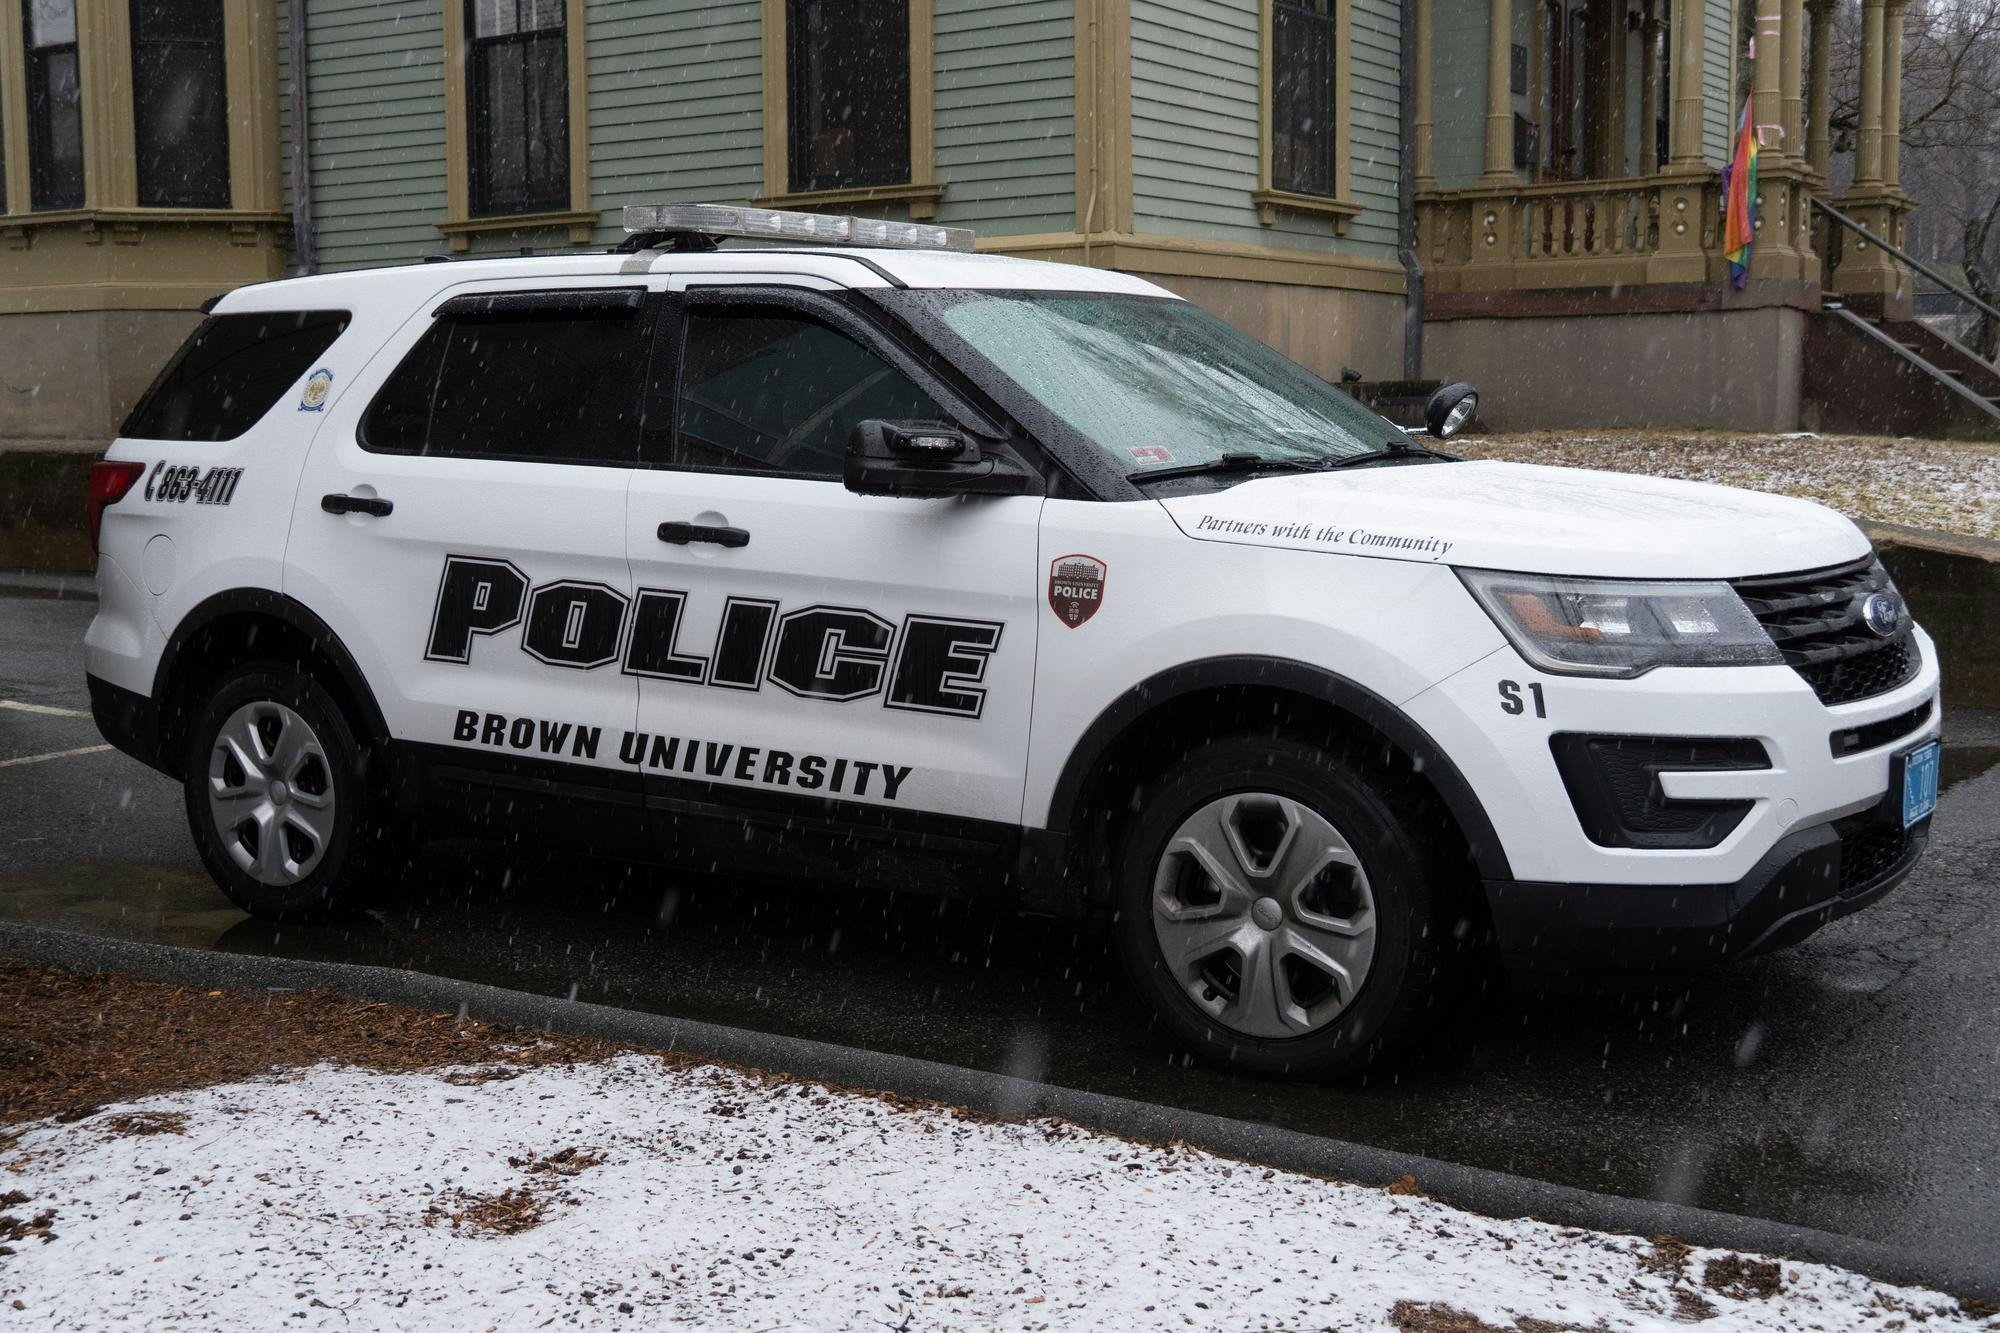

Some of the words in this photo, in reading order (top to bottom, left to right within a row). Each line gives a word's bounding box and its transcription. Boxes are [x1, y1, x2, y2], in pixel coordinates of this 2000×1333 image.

[156, 465, 245, 505] 863-4111
[1196, 514, 1268, 535] Partners
[1272, 522, 1312, 540] with
[1316, 525, 1344, 543] the
[1348, 528, 1453, 561] Community
[1053, 585, 1098, 600] POLICE
[422, 552, 1007, 721] POLICE
[453, 709, 601, 759] BROWN
[619, 731, 913, 800] UNIVERSITY
